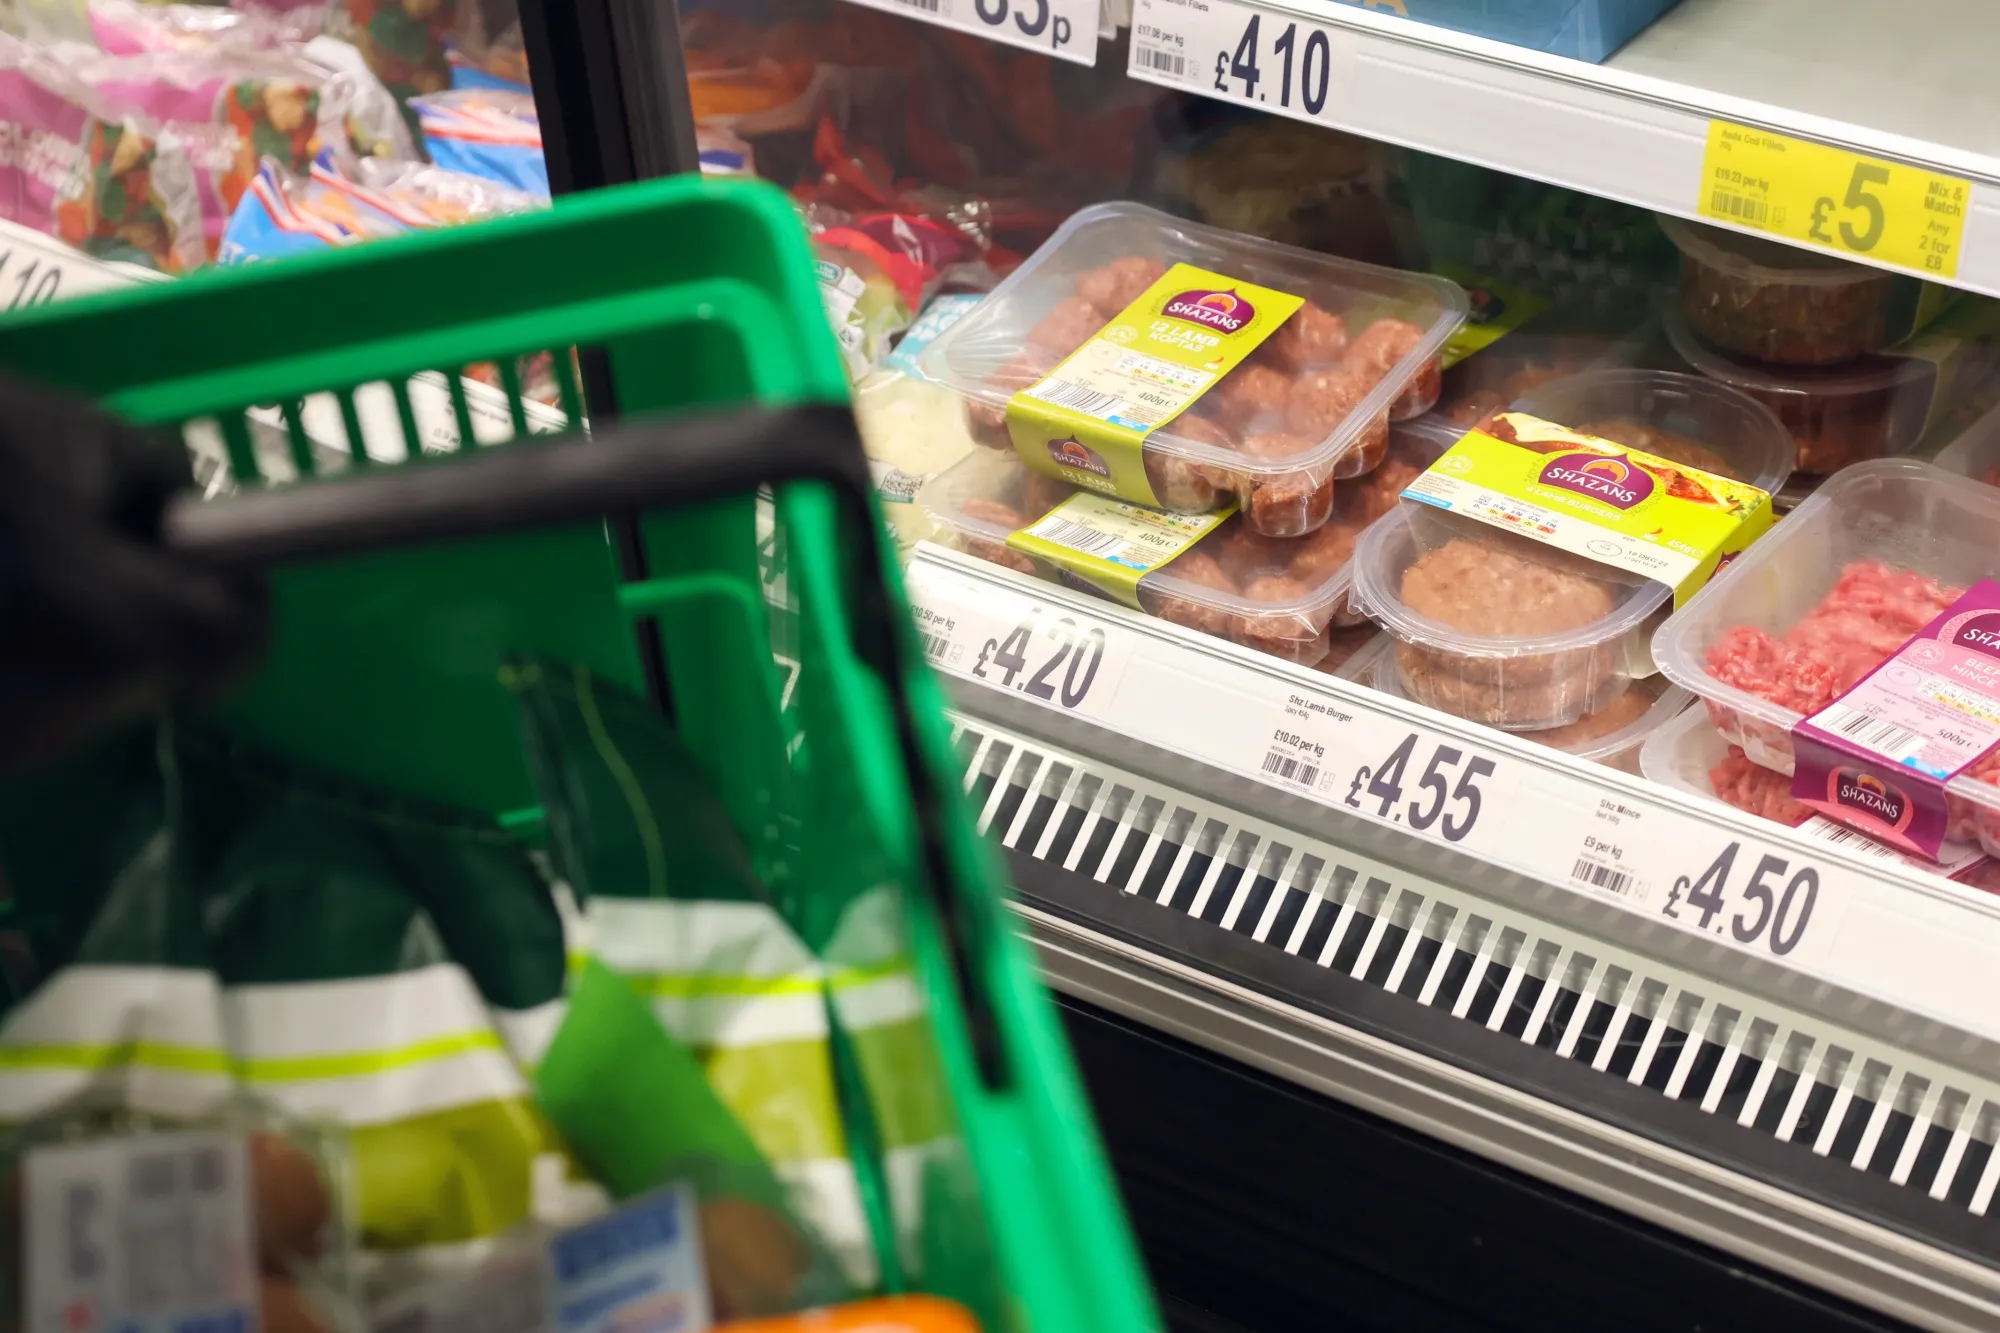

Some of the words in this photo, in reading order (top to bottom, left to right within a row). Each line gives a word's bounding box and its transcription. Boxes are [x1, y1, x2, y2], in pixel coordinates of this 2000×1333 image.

[1161, 32, 1174, 43] per
[1175, 33, 1184, 47] kg
[1214, 14, 1330, 116] £4.10
[1744, 134, 1760, 146] Cod
[1743, 175, 1757, 188] per
[1758, 177, 1769, 193] kg
[1928, 181, 1950, 198] Mix
[1952, 187, 1963, 202] &
[1808, 161, 1890, 252] £5
[1924, 196, 1961, 217] Match
[1927, 219, 1950, 236] Any
[1918, 235, 1929, 250] 2
[1931, 237, 1951, 255] for
[1168, 302, 1242, 330] SHAZANS
[1148, 332, 1204, 353] KOFTAS
[1149, 320, 1168, 332] 12
[1169, 325, 1220, 347] LAMB
[1138, 391, 1165, 406] 400g
[1053, 452, 1107, 475] SHAZANS
[1547, 467, 1637, 502] SHAZANS
[1533, 488, 1567, 503] LAMB
[1567, 499, 1623, 521] BURGERS
[1138, 532, 1165, 546] 400g
[933, 614, 945, 629] per
[945, 617, 955, 631] kg
[972, 607, 1106, 708] £4.20
[1950, 664, 1999, 688] MINCE
[1284, 705, 1297, 716] Spicy
[1289, 694, 1304, 706] Shz
[1304, 700, 1326, 714] Lamb
[1326, 707, 1353, 722] Burger
[1274, 729, 1301, 747] £10.02
[1299, 739, 1314, 751] per
[1313, 743, 1325, 758] kg
[1937, 728, 1966, 746] 500g
[1345, 733, 1497, 842] £4.55
[1600, 799, 1616, 810] Shz
[1616, 805, 1641, 819] Mince
[1841, 784, 1899, 818] SHAZANS
[1584, 835, 1597, 848] £9
[1595, 842, 1610, 852] per
[1611, 845, 1623, 860] kg
[1663, 841, 1819, 956] £4.50
